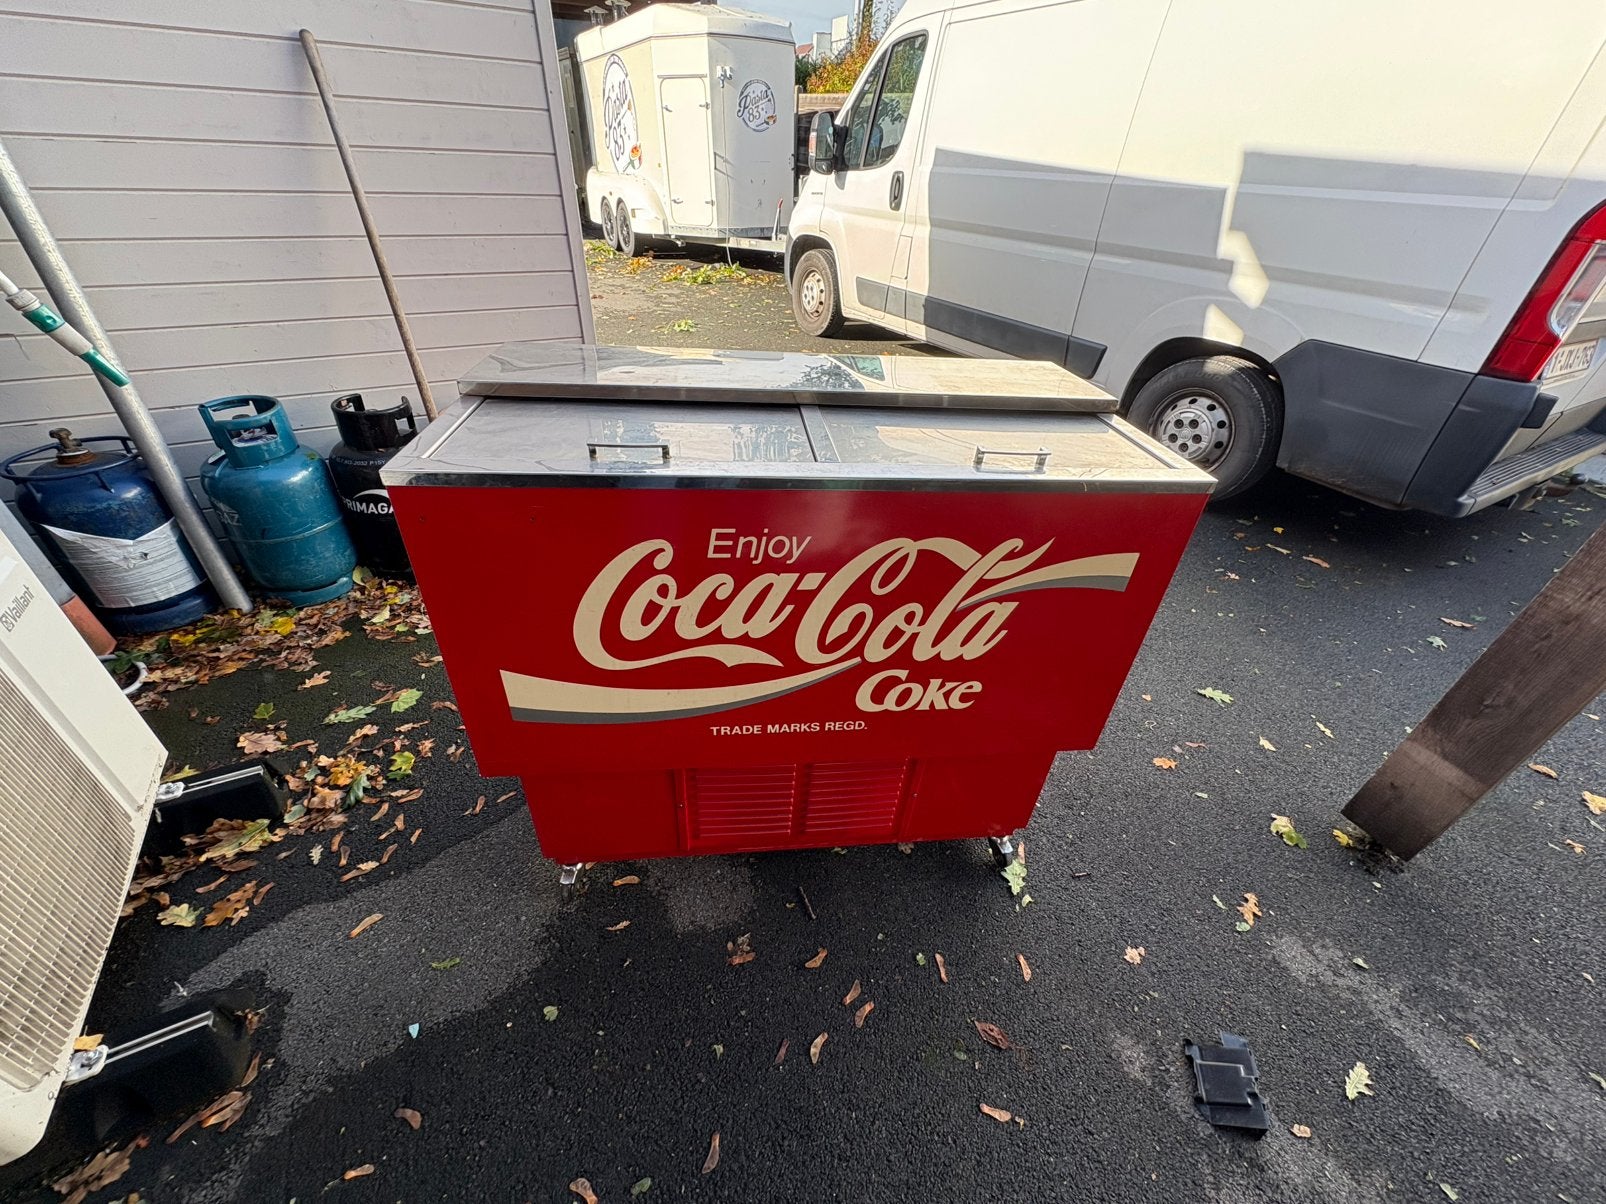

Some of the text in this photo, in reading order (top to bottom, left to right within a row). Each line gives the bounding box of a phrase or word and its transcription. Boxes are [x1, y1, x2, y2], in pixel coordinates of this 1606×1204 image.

[737, 89, 770, 118] Pasta
[747, 105, 761, 122] 83
[707, 528, 812, 564] Enjoy
[4, 584, 35, 623] Vaillant
[573, 537, 1056, 671] Coca-Cola
[855, 669, 983, 713] Coke
[710, 720, 868, 736] TRADE MARKS REGD.
